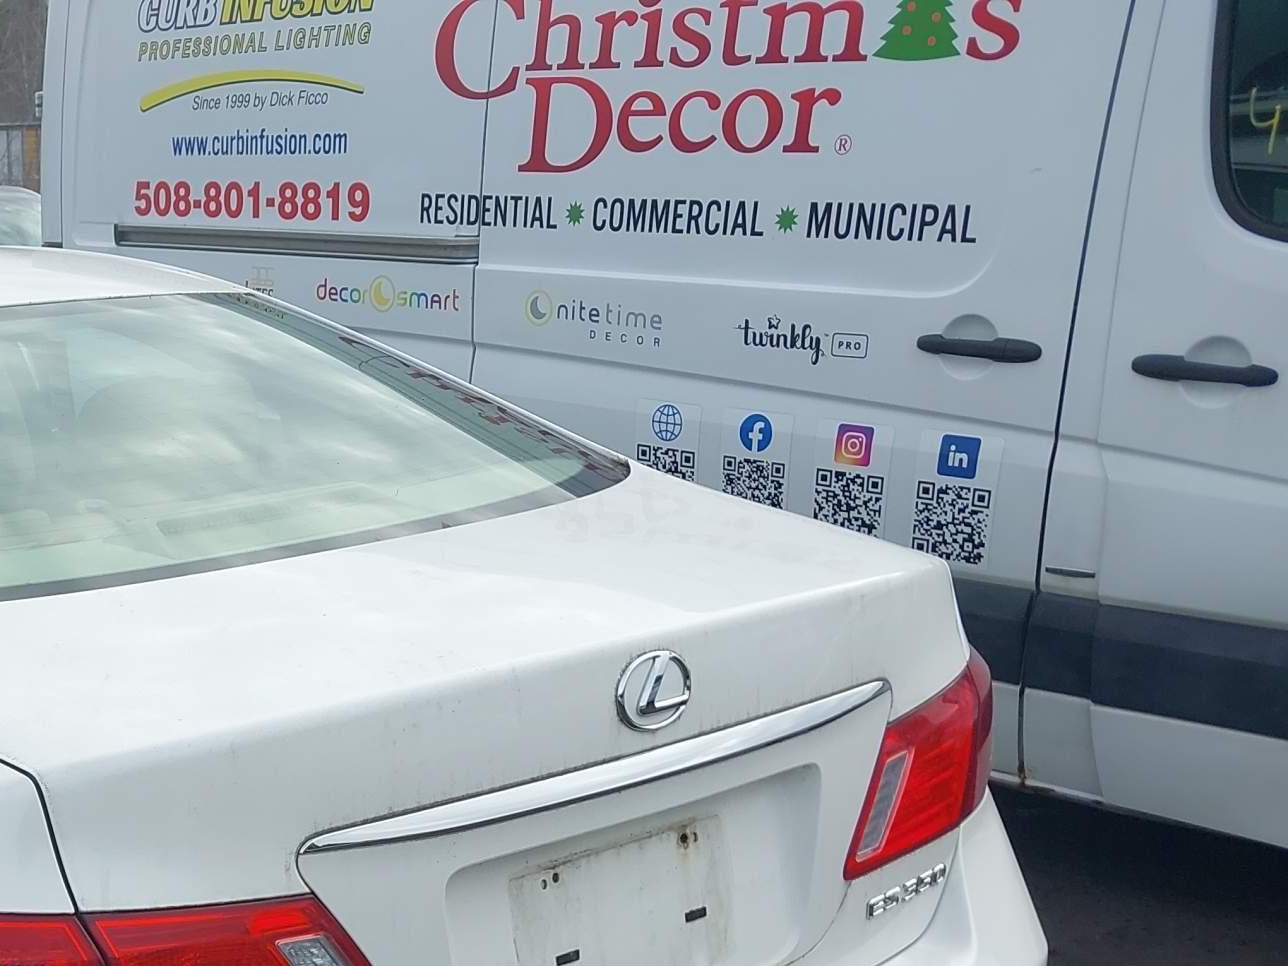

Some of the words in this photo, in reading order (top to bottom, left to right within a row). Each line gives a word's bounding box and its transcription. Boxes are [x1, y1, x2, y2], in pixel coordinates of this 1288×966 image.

[219, 0, 375, 26] INFUS
[138, 31, 267, 62] PROFESSIONAL
[274, 22, 372, 51] LIGHTING
[192, 95, 221, 111] Since
[225, 94, 250, 109] 1999
[253, 91, 267, 111] by
[269, 91, 295, 107] Dick
[297, 90, 329, 106] Ficco
[517, 76, 842, 173] Decor
[172, 128, 348, 156] www.curbinfusion.com
[134, 180, 371, 222] 508-801-8819
[419, 193, 558, 229] RESIDENTIAL
[592, 197, 765, 237] COMMERCIAL
[806, 201, 977, 244] MUNICIPAL
[316, 278, 369, 304] decor
[589, 329, 661, 348] DECOR
[734, 318, 825, 365] twinkly
[837, 340, 862, 351] PRO
